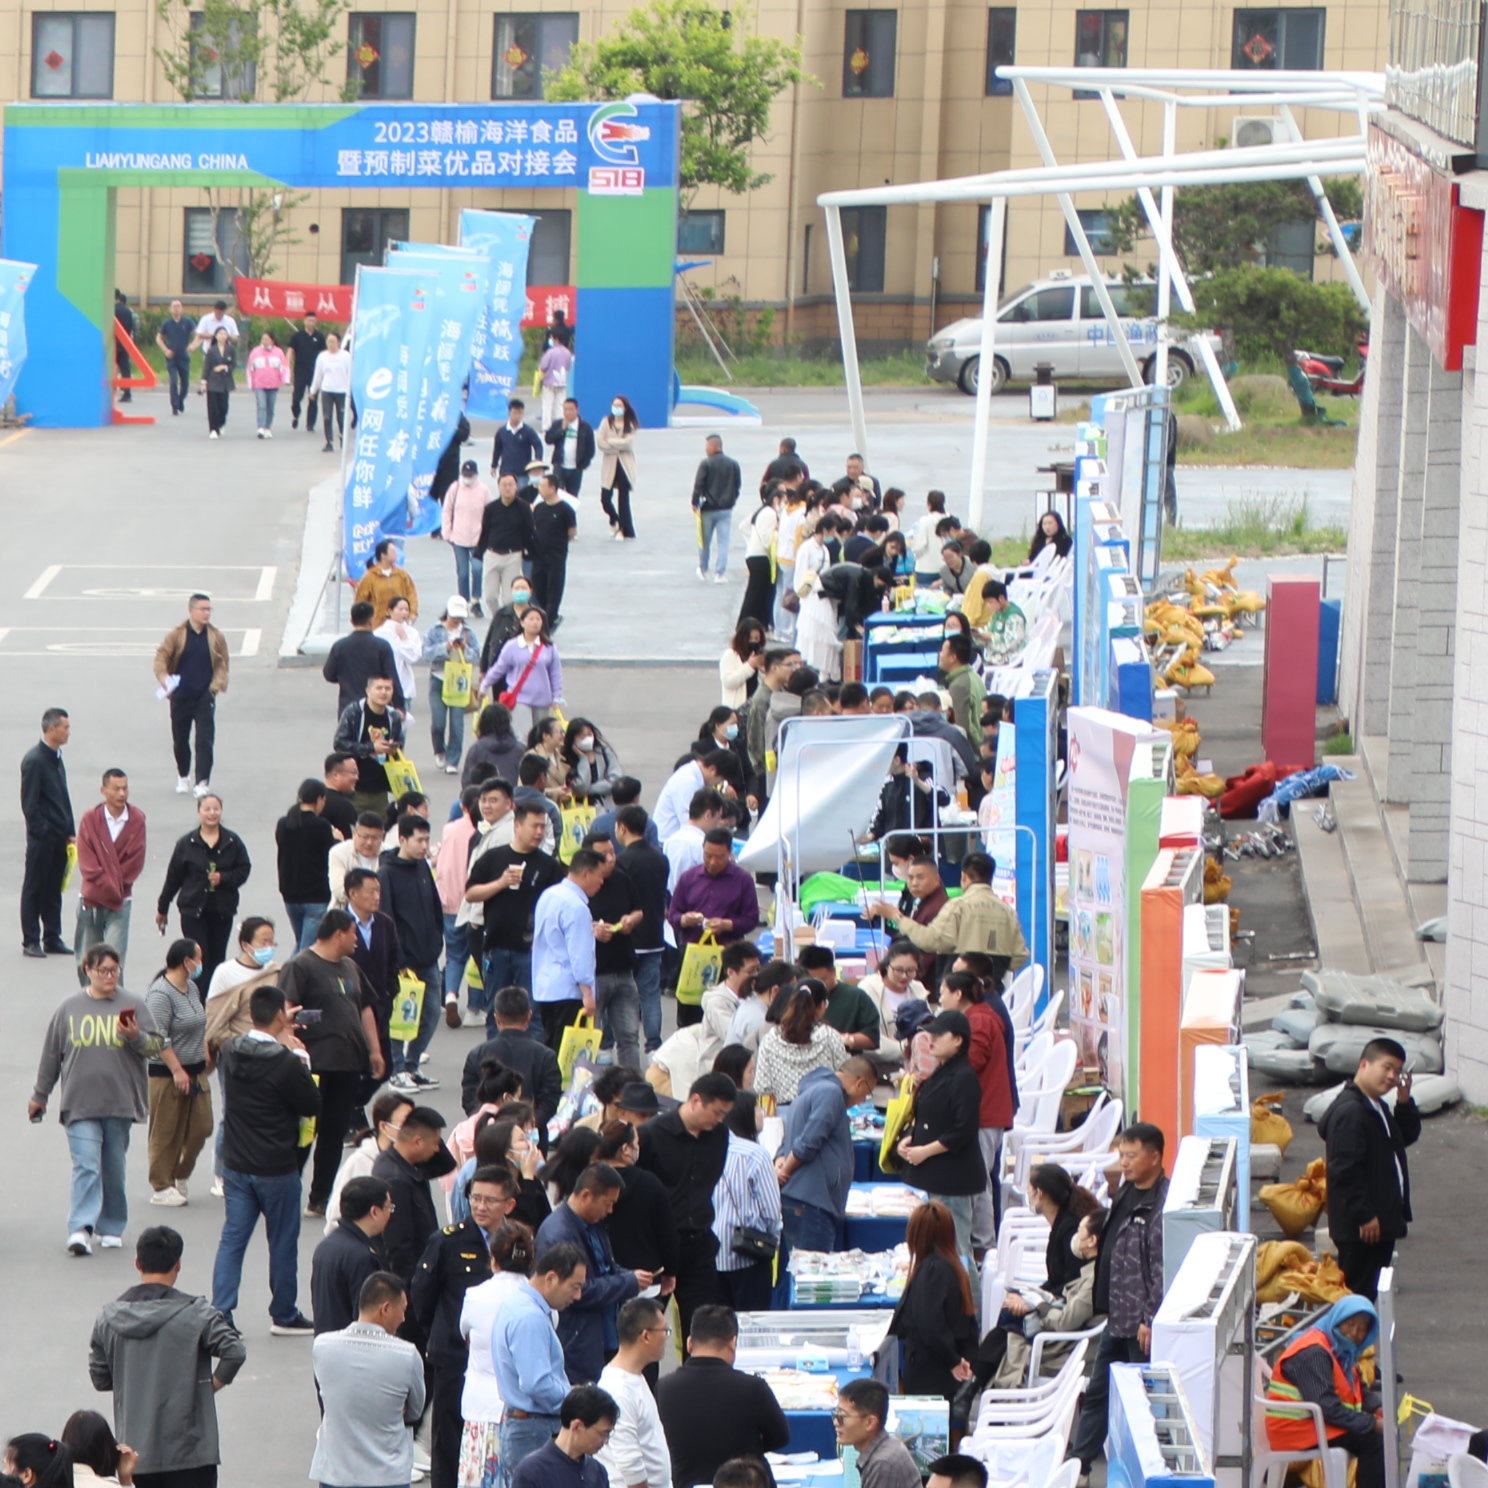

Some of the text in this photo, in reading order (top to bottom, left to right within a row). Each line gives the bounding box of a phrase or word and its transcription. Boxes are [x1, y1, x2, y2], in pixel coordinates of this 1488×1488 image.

[374, 119, 578, 145] 2023赣榆海洋食品
[86, 152, 249, 170] LIANYUNGANG CHINA
[336, 150, 578, 177] 暨预制菜优品对接会
